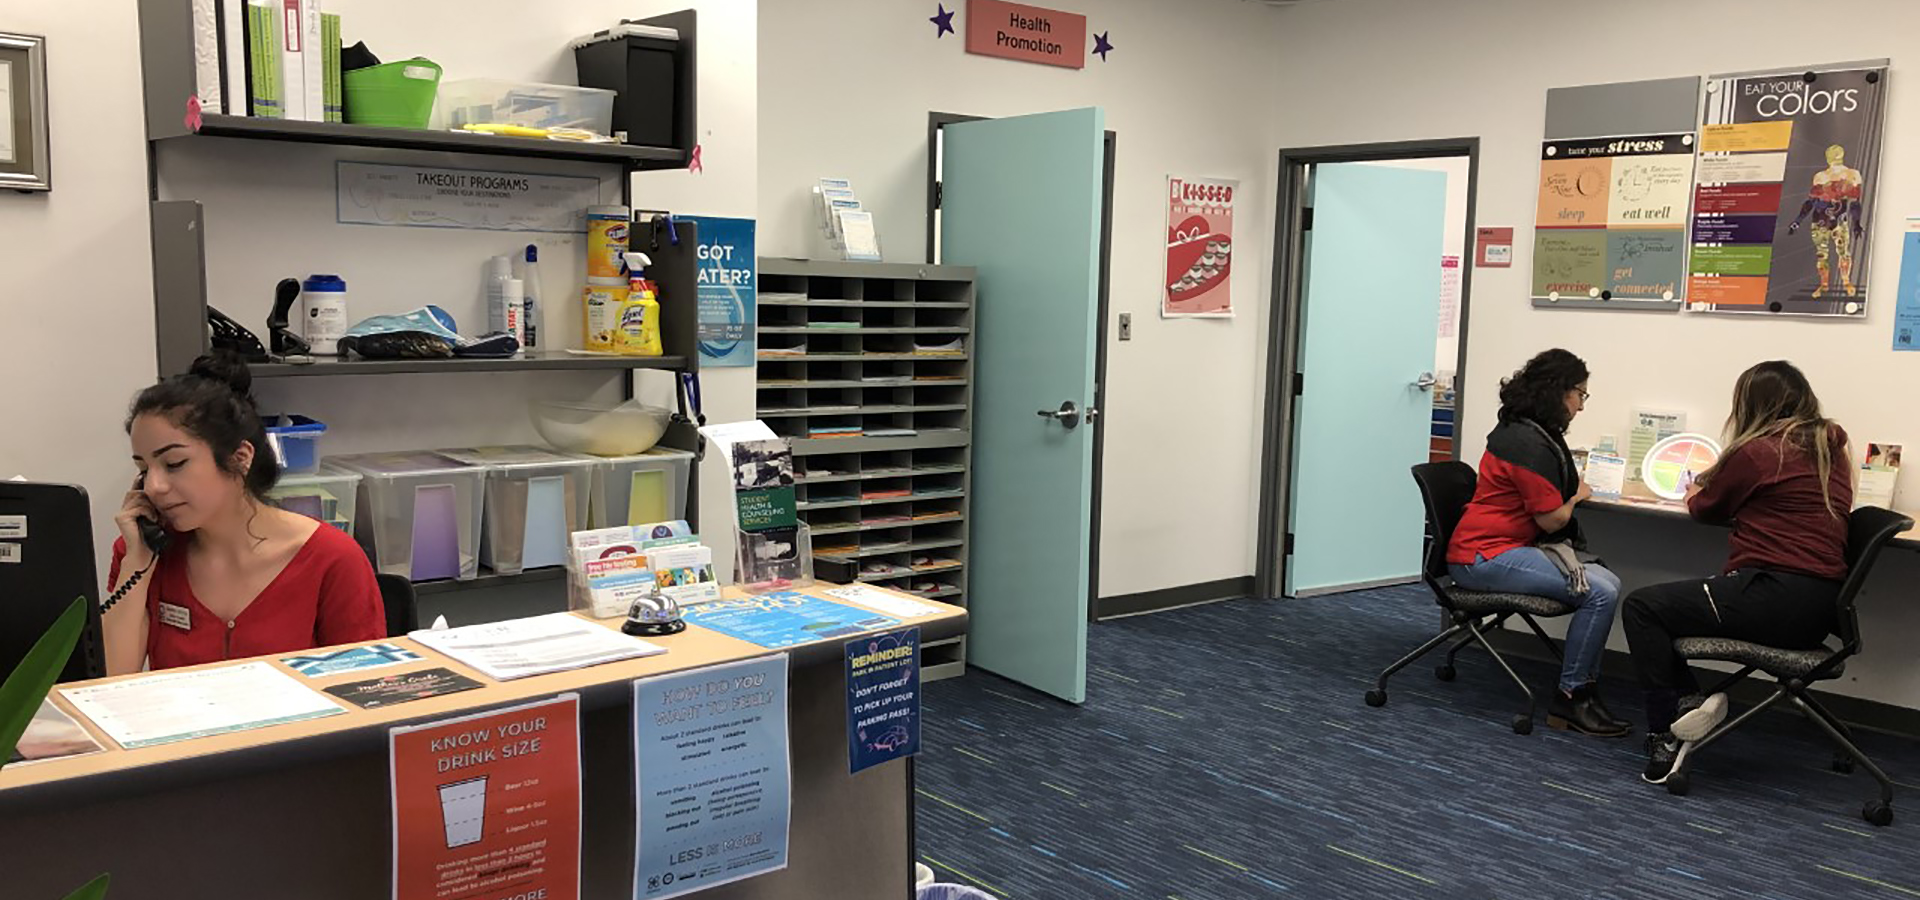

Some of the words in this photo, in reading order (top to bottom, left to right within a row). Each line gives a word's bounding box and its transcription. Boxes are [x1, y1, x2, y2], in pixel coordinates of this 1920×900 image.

[1010, 12, 1051, 34] Health
[996, 31, 1062, 55] Promotion
[1745, 83, 1765, 96] EAT
[1769, 80, 1804, 94] YOUR
[1756, 84, 1859, 117] colors
[1607, 139, 1665, 153] stress
[416, 172, 466, 188] TAKEOUT
[470, 177, 529, 192] PROGRAMS
[1557, 208, 1585, 222] sleep
[1622, 208, 1642, 219] eat
[1645, 206, 1671, 219] well
[697, 244, 734, 261] GOT
[697, 267, 751, 285] ATER?
[1613, 266, 1633, 281] get
[852, 645, 912, 669] REMINDER:
[662, 684, 701, 705] HOW
[706, 679, 730, 696] DO
[733, 673, 766, 690] YOU
[878, 677, 909, 692] FORGET
[653, 704, 703, 726] WANT
[706, 699, 728, 716] TO
[853, 704, 864, 714] TO
[864, 700, 880, 712] PICK
[881, 697, 892, 706] UP
[893, 691, 914, 704] YOUR
[857, 712, 888, 729] PARKING
[888, 707, 910, 720] PASS!
[431, 729, 490, 752] KNOW
[497, 717, 547, 738] YOUR
[437, 749, 497, 772] DRINK
[501, 737, 541, 758] SIZE
[504, 783, 522, 791] Beer
[506, 805, 525, 814] Wine
[669, 847, 703, 866] LESS
[706, 843, 719, 857] IS
[722, 831, 763, 853] MORE
